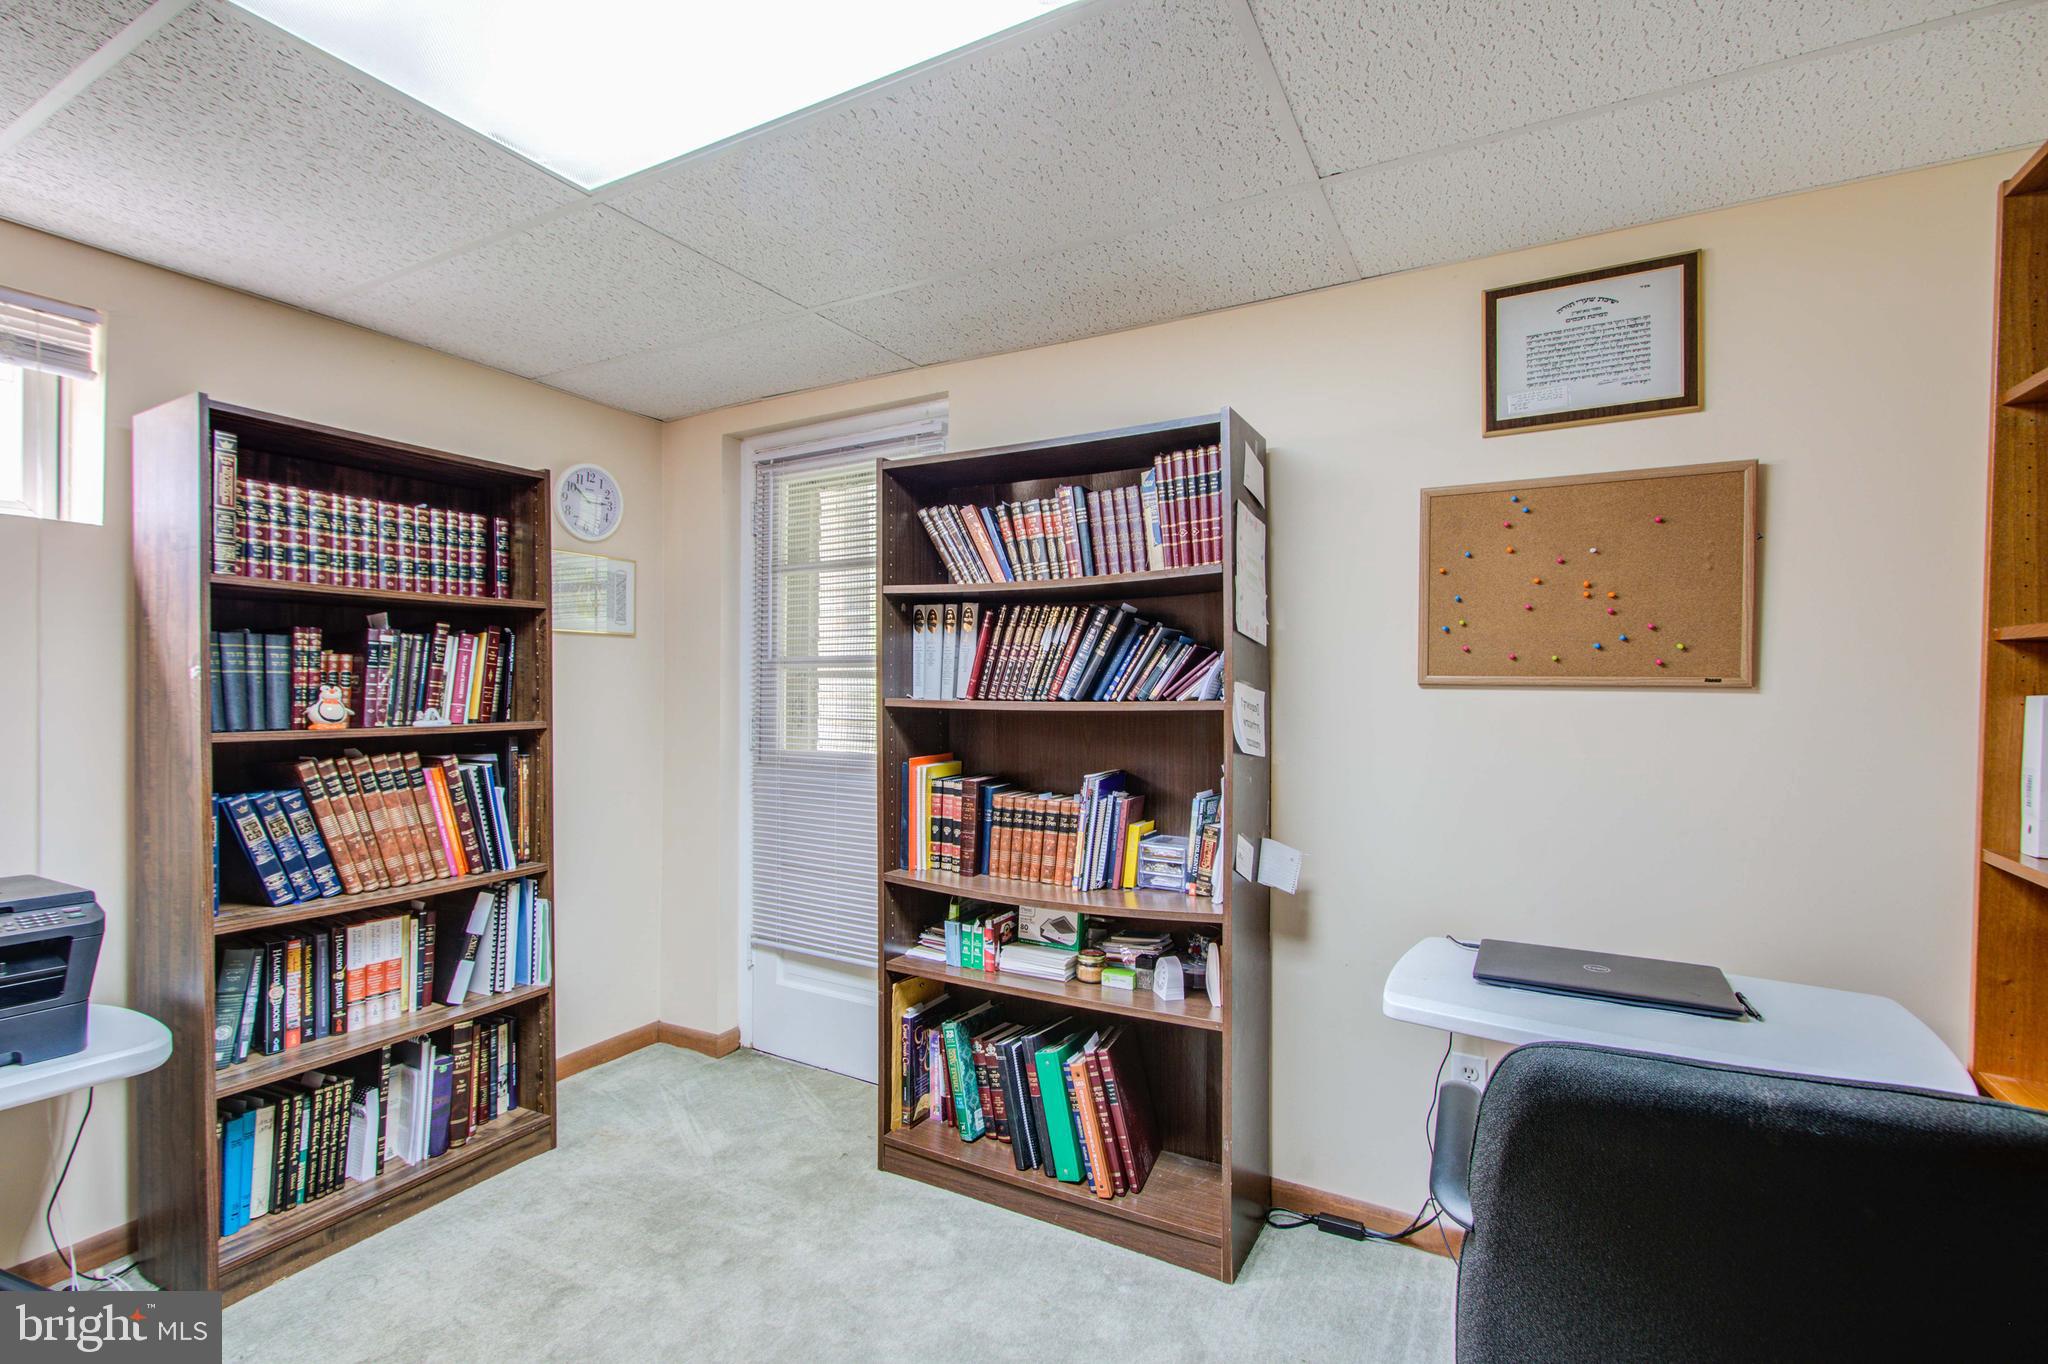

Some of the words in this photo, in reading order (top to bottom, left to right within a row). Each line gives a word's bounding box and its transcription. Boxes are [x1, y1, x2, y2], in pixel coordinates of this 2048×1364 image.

[576, 473, 584, 485] 11
[587, 471, 596, 483] 12
[561, 491, 569, 501] 9
[604, 489, 611, 500] 2
[564, 504, 572, 516] 8
[1192, 844, 1201, 877] DILIGENTLY
[335, 934, 344, 970] HALACHOS
[272, 949, 282, 986] HALACHOS
[335, 982, 344, 1009] REFUAH
[272, 999, 282, 1032] BROCHOS
